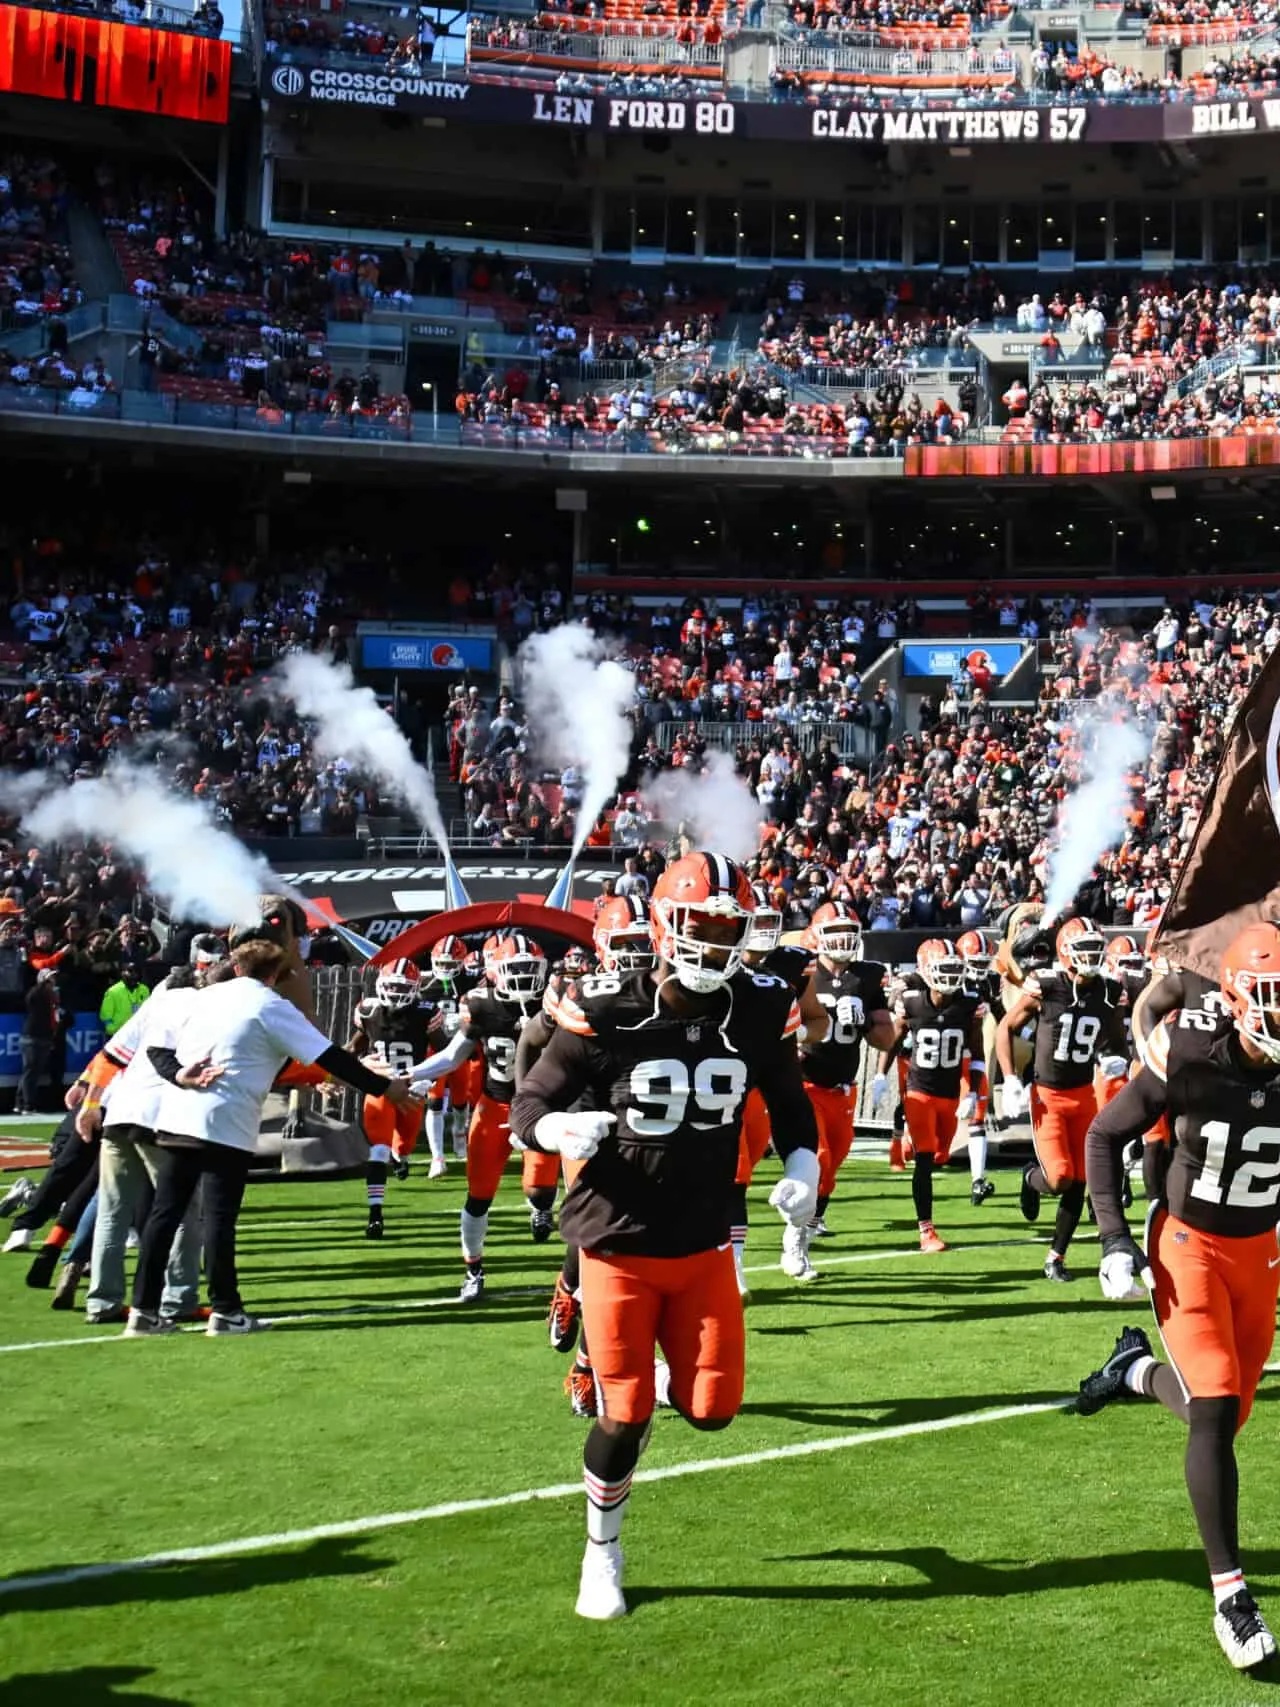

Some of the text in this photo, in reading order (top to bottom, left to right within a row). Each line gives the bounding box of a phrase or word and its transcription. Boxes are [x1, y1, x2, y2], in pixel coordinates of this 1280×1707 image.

[310, 68, 470, 100] CROSSCOUNTRY
[310, 85, 397, 107] MORTGAGE
[533, 94, 735, 134] LEN FORD 80
[812, 107, 1087, 140] CLAY MATTHEWS 57
[1192, 101, 1256, 133] BILL
[65, 1030, 104, 1053] NF
[916, 1028, 964, 1069] 80
[1053, 1012, 1101, 1063] 19
[626, 1057, 748, 1136] 99
